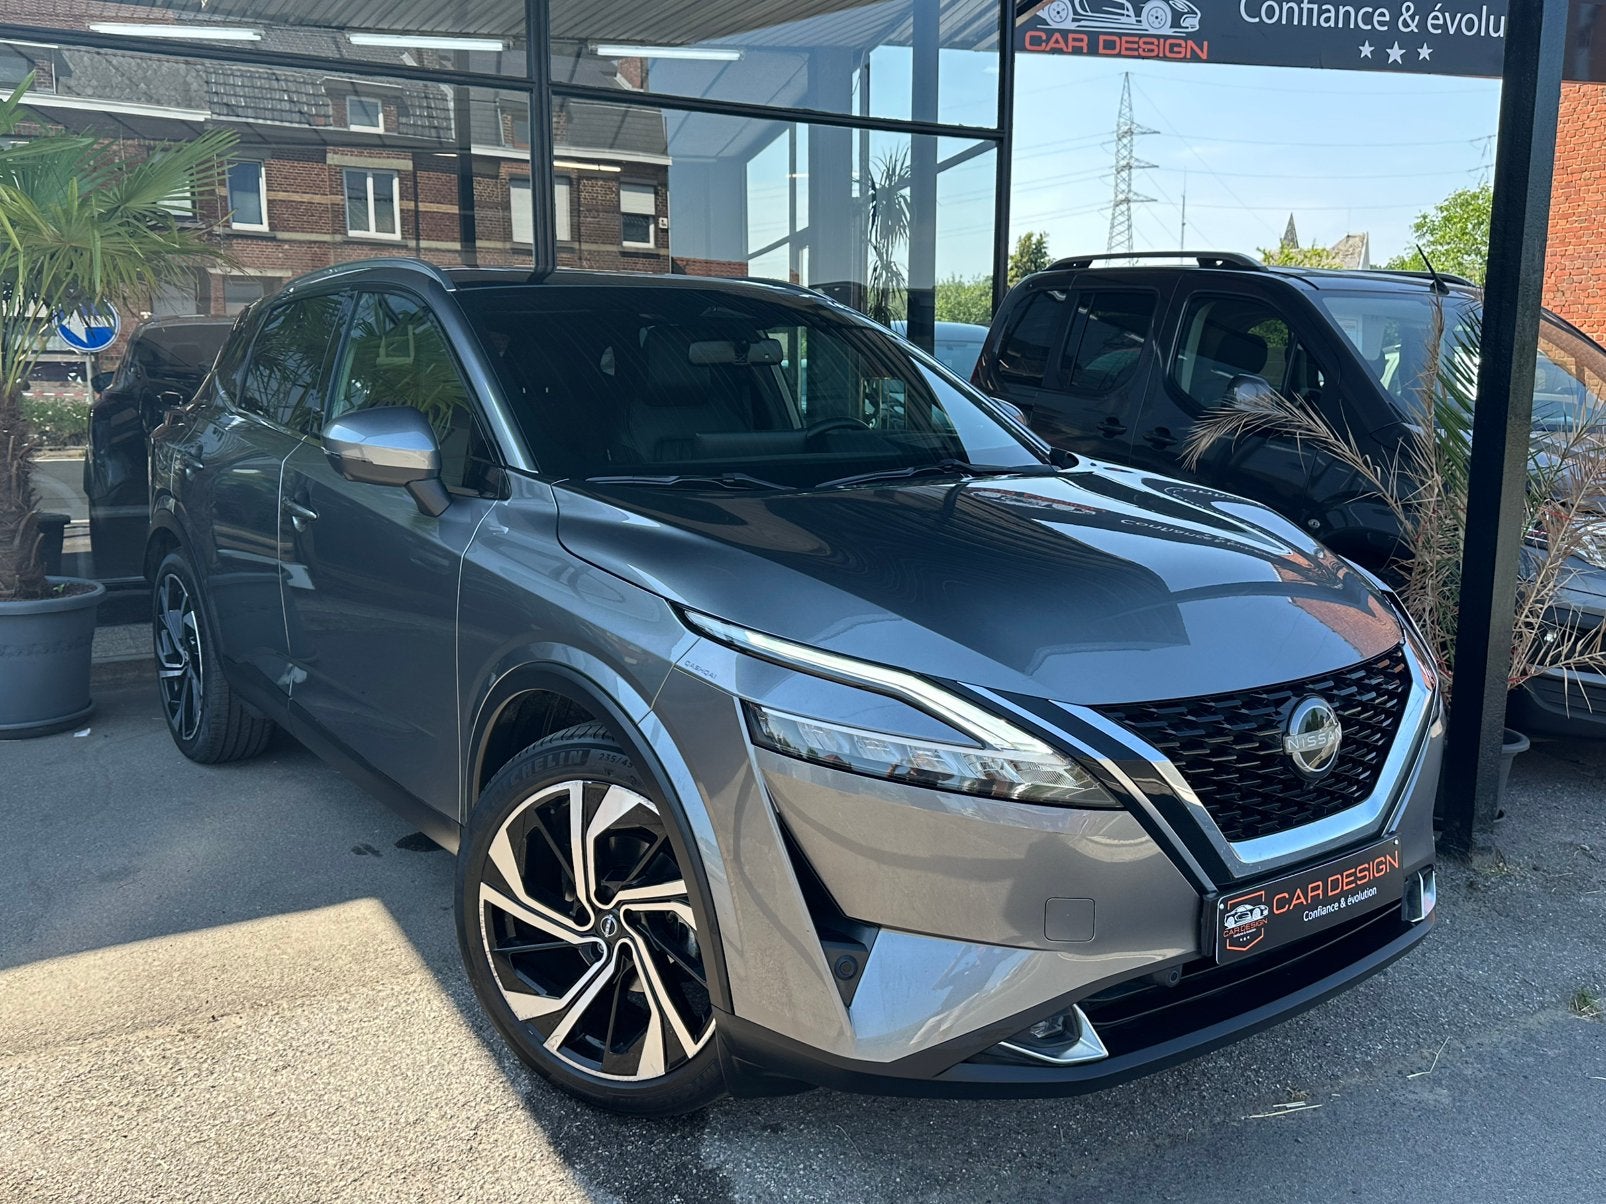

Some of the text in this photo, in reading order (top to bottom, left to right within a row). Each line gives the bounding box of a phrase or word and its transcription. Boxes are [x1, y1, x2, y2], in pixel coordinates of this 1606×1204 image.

[1239, 0, 1390, 31] Confiance
[1397, 2, 1420, 33] &
[1025, 31, 1208, 60] CAR DESIGN
[684, 660, 717, 680] QASHQAI
[1288, 727, 1341, 750] NISSAN
[1273, 850, 1399, 915] CAR DESIGN
[1303, 886, 1377, 921] Confiance & évolution
